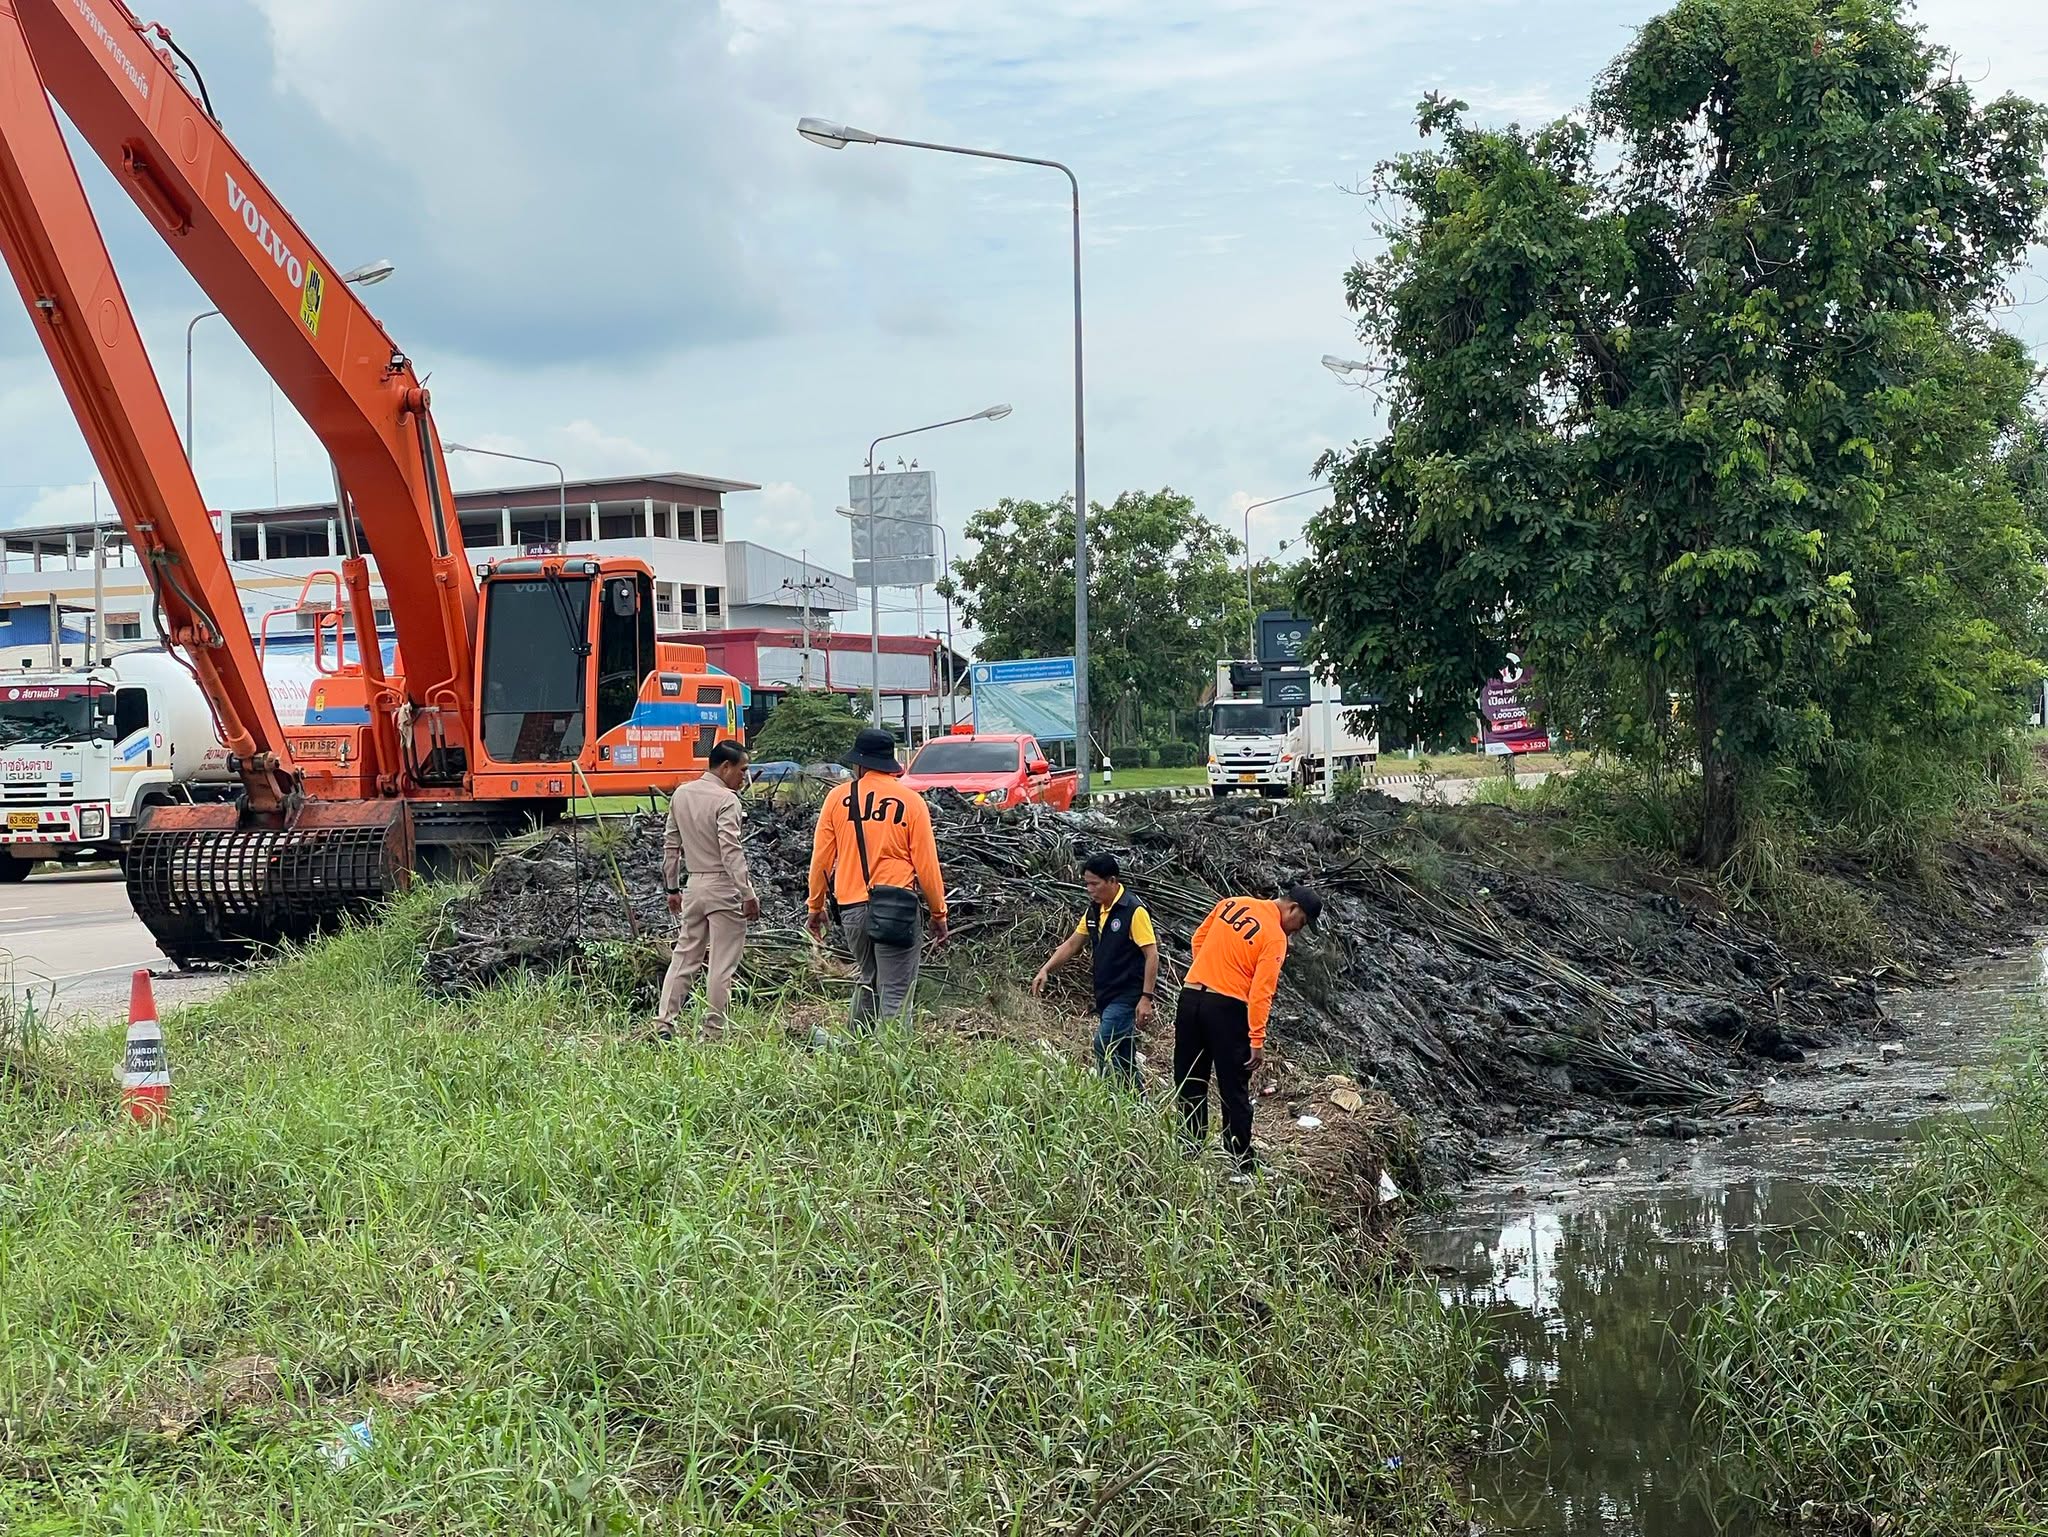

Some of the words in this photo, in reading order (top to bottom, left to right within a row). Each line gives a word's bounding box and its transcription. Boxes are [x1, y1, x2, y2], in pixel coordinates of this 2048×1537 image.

[225, 172, 303, 288] VOLVO
[513, 583, 568, 593] VOL
[22, 687, 59, 699] สยามแก๊ส
[5, 772, 42, 780] ISUZU
[843, 791, 907, 827] ปภ.
[1219, 900, 1261, 945] ปภ.
